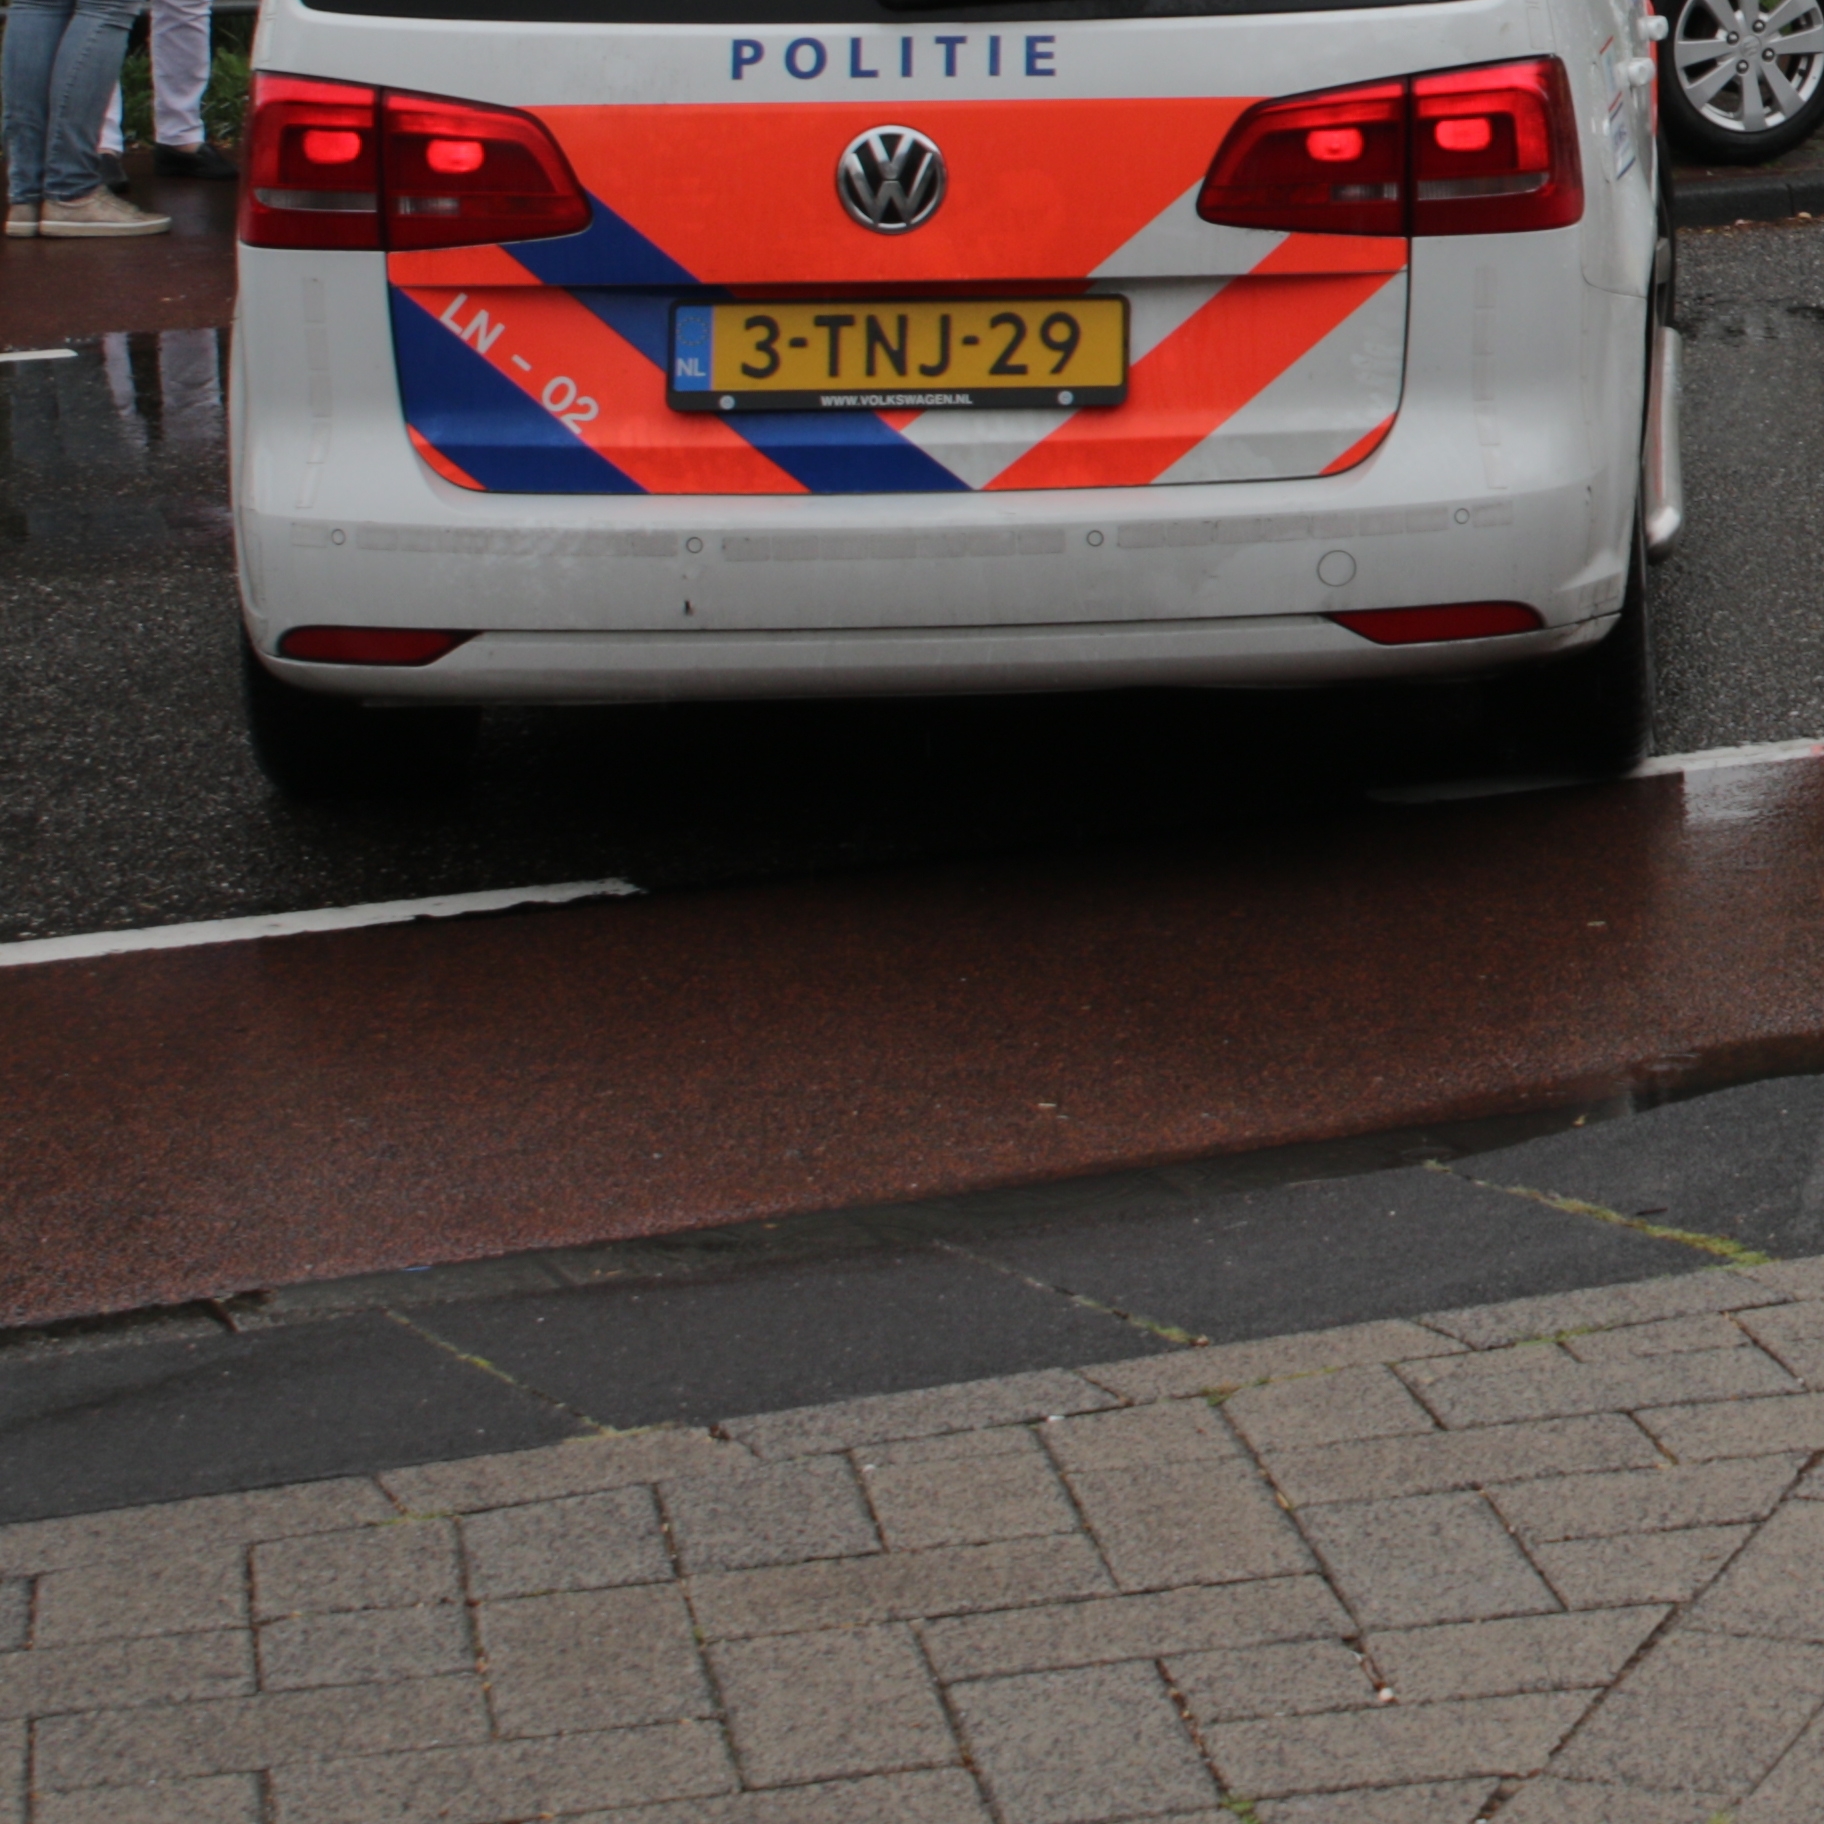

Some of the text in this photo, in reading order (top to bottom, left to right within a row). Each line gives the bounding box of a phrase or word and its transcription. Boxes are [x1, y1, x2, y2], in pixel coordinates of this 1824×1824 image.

[730, 34, 1057, 81] POLITIE
[439, 292, 505, 354] LN
[541, 376, 599, 435] 02
[676, 312, 1082, 379] NL 3-TNJ-29
[820, 393, 974, 407] WWW.VOLKSWAGEN.NL
